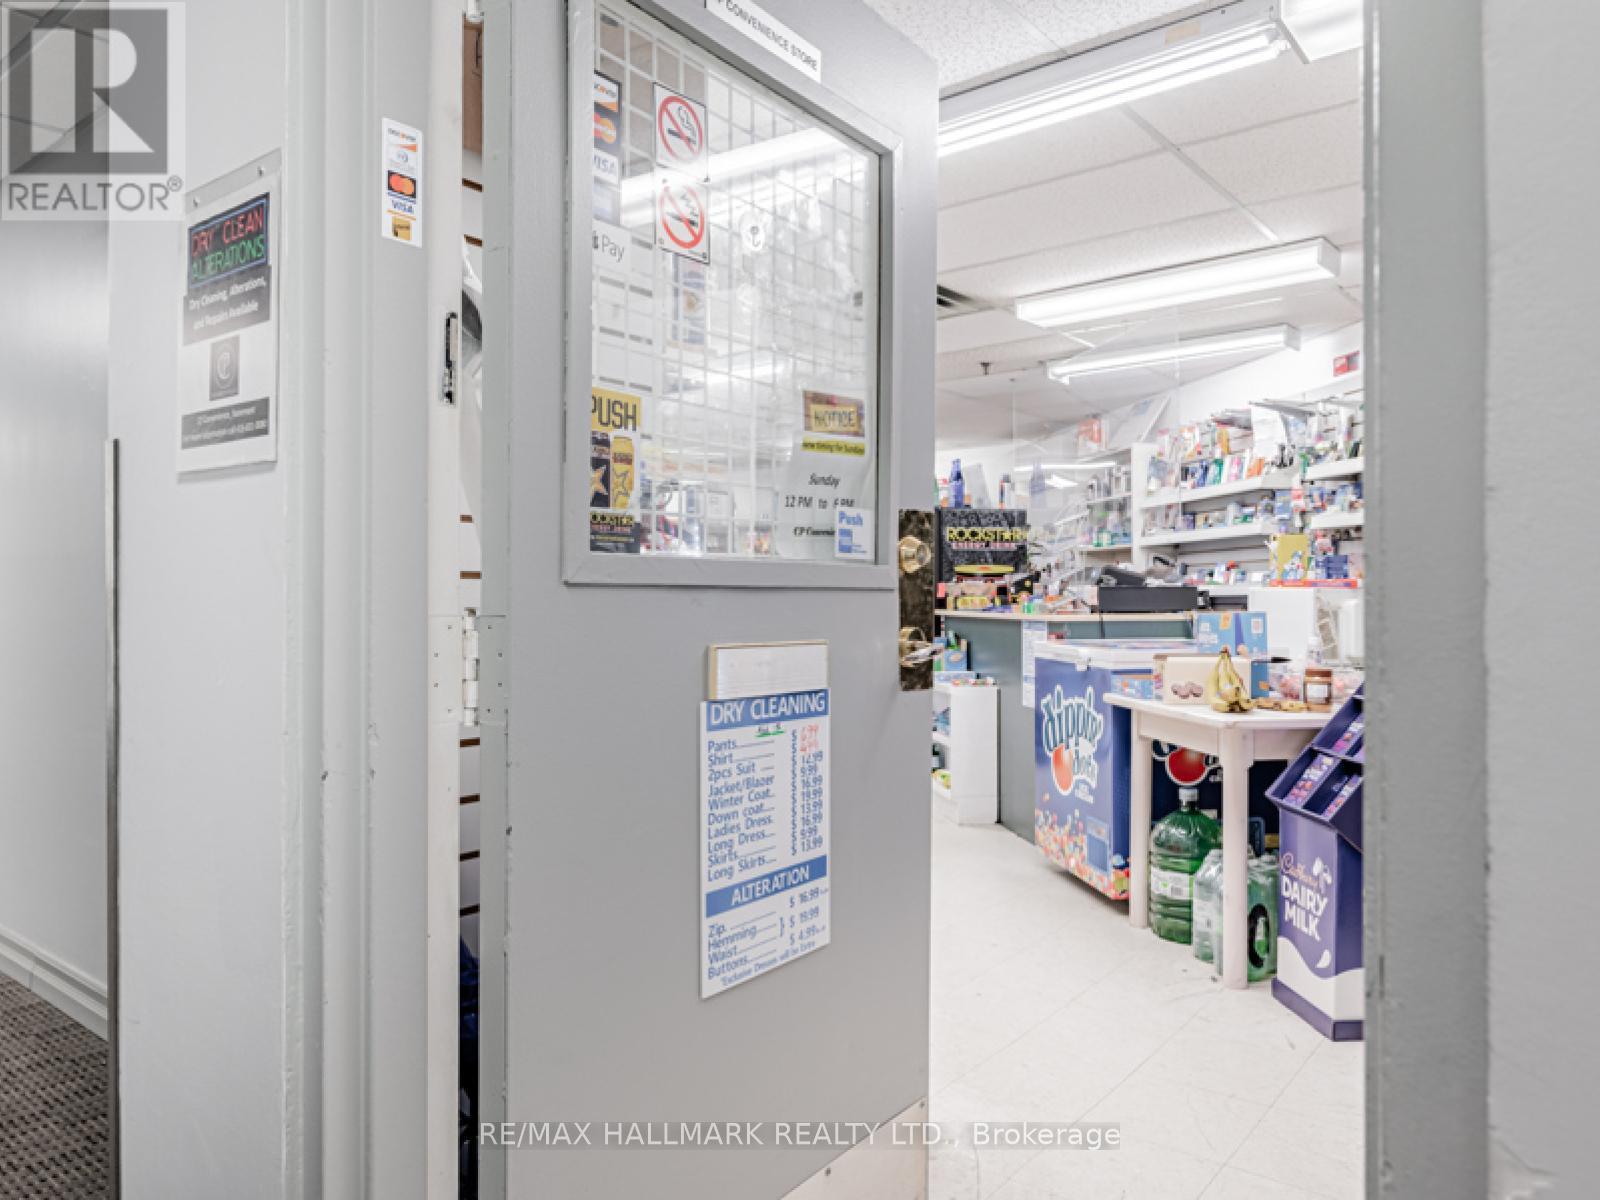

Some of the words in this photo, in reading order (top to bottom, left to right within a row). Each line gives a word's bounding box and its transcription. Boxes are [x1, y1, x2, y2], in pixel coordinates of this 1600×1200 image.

[726, 0, 789, 51] CONVENIENCE
[790, 44, 817, 70] STORE
[223, 207, 263, 244] CLEAN
[192, 235, 265, 279] ALTERATIONS
[601, 235, 625, 262] Pay
[814, 409, 855, 428] NOTICE
[808, 472, 841, 489] Sunday
[785, 495, 796, 507] 12
[798, 496, 813, 507] PM
[838, 511, 863, 526] Push
[711, 701, 745, 725] DRY
[752, 692, 825, 720] CLEANING
[708, 739, 737, 753] Pants
[708, 752, 733, 768] Shirt
[708, 767, 732, 783] 2pcs
[736, 761, 756, 776] Suit
[708, 793, 744, 811] Winter
[748, 787, 771, 802] Coat
[708, 808, 739, 826] Down
[708, 822, 741, 840] Ladies
[746, 814, 772, 830] Dress
[708, 839, 734, 854] Long
[738, 830, 766, 845] Dress
[708, 849, 737, 868] Skirts
[708, 865, 734, 882] Long
[738, 857, 766, 872] Skirts
[731, 865, 809, 906] ALTERATION
[1282, 874, 1328, 917] DAIRY
[1284, 901, 1321, 942] MILK
[708, 926, 757, 951] Hemming
[708, 945, 737, 965] Waist
[708, 956, 749, 980] Buttons
